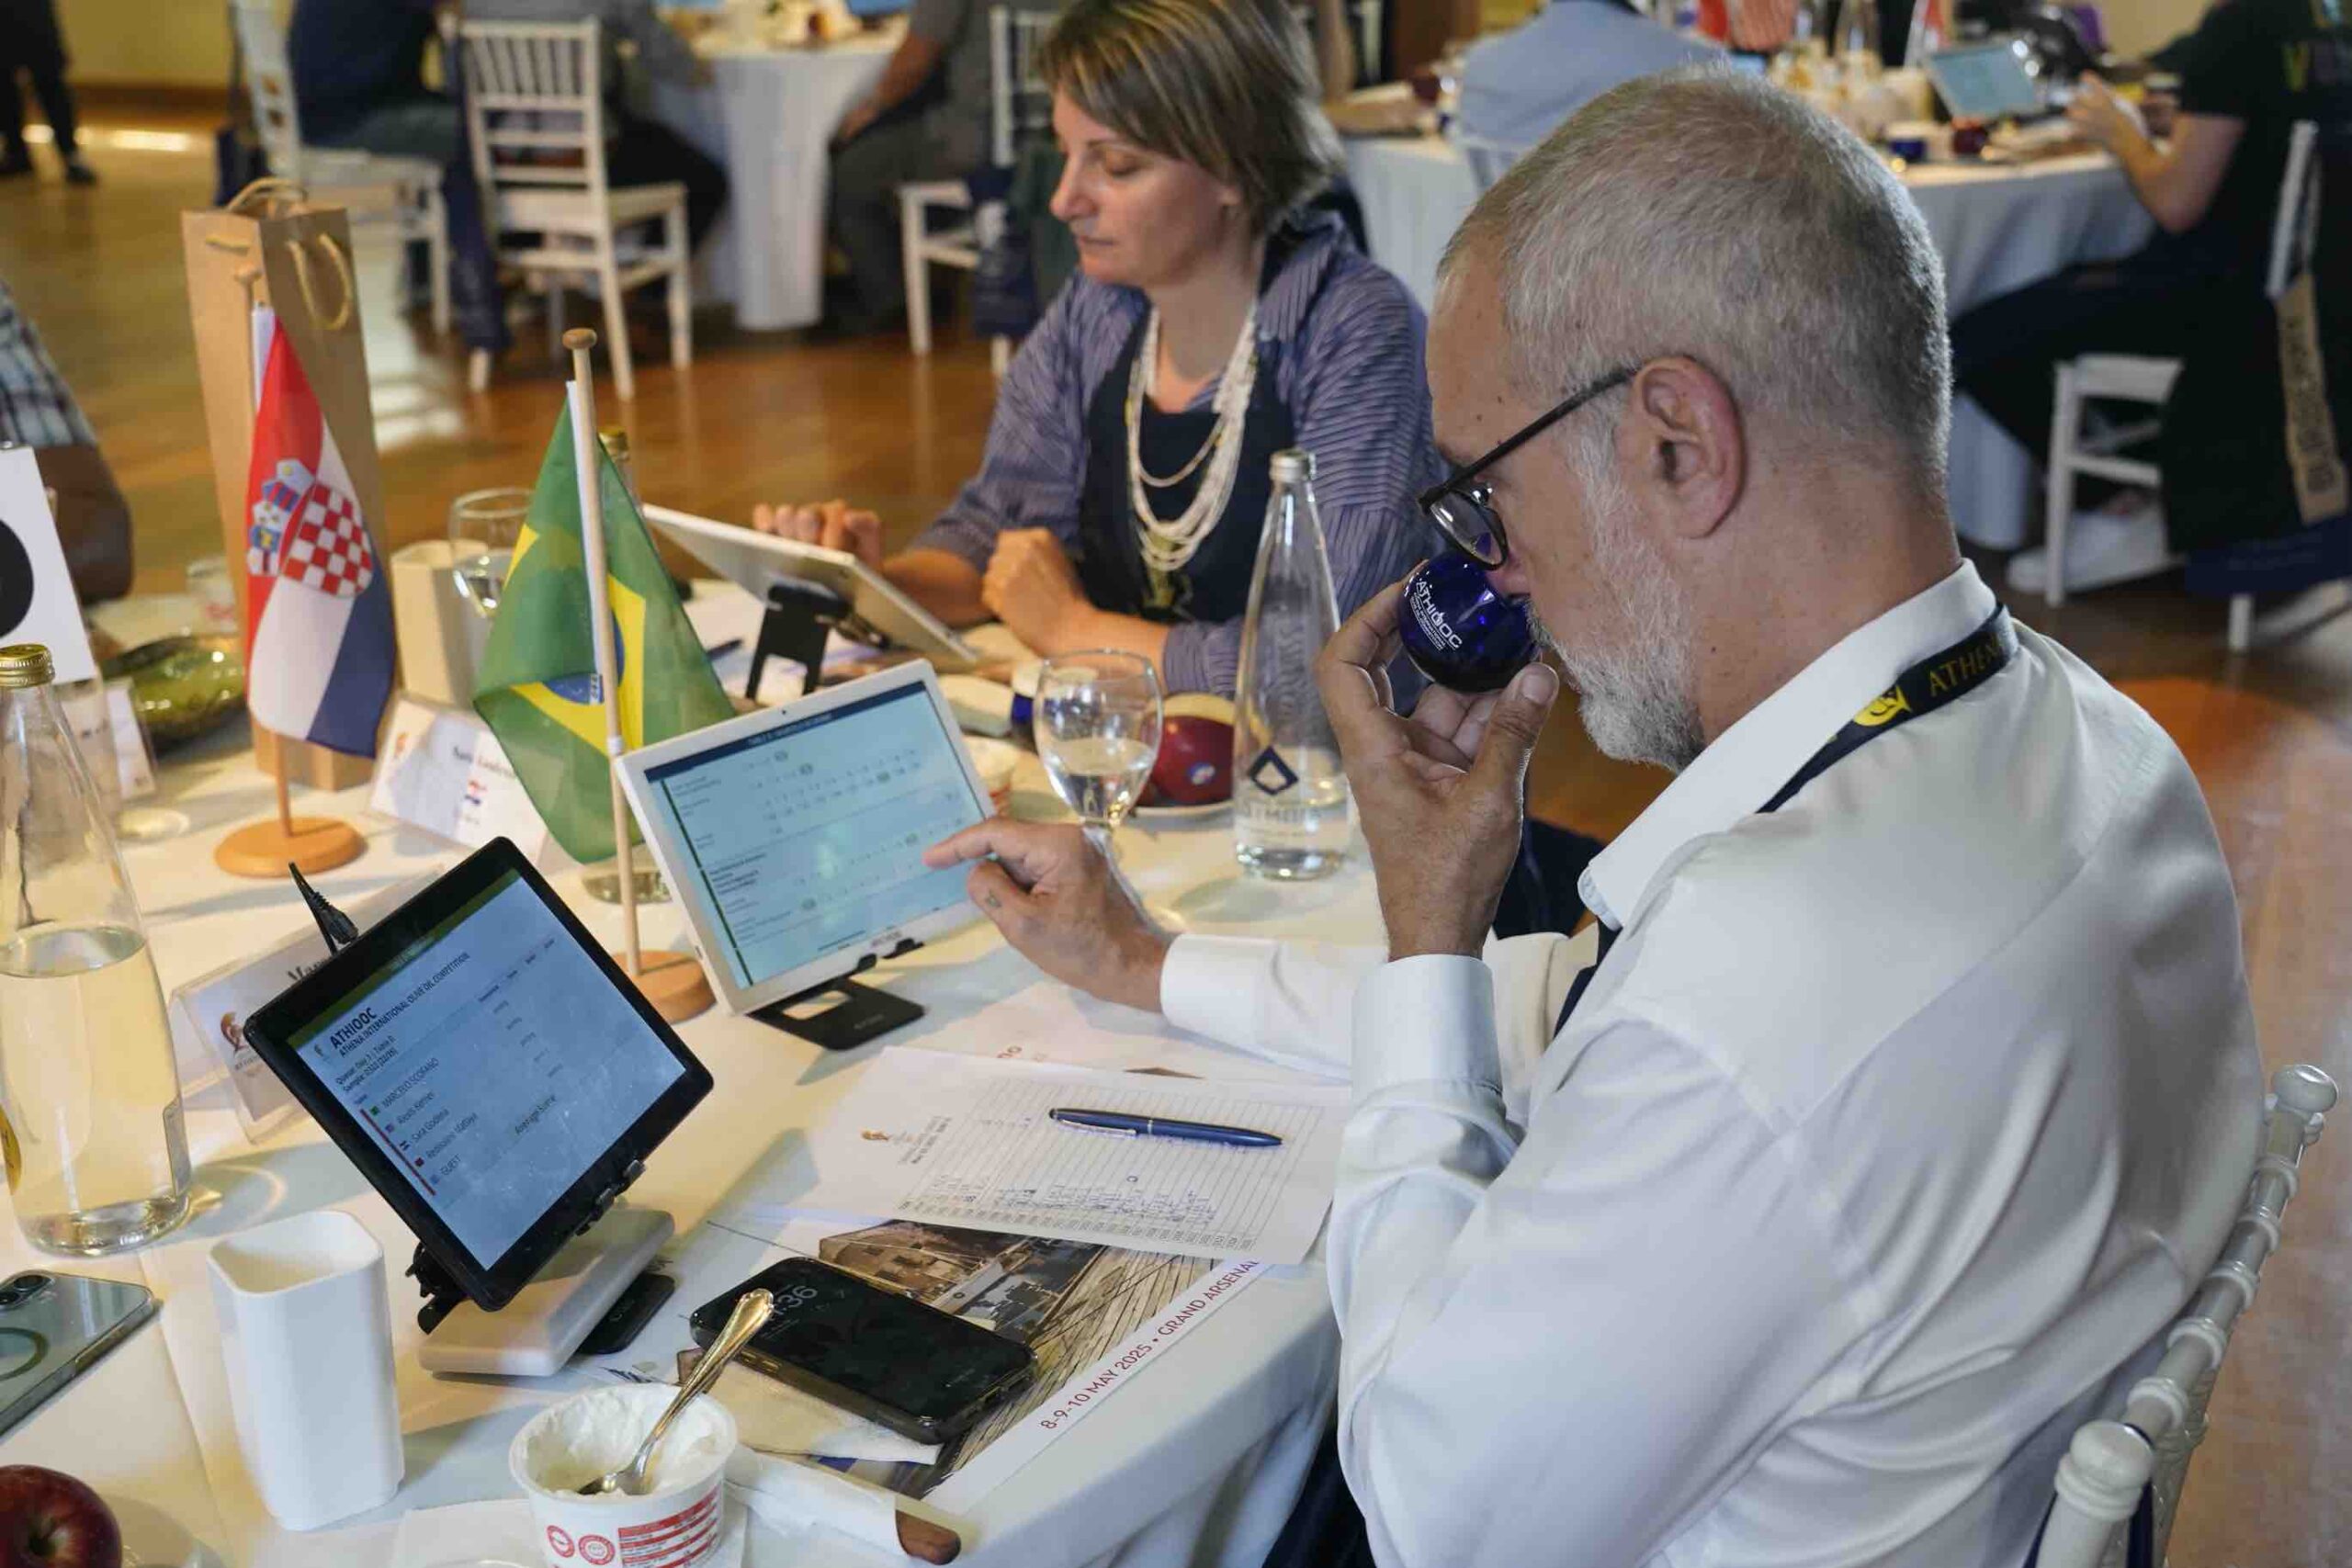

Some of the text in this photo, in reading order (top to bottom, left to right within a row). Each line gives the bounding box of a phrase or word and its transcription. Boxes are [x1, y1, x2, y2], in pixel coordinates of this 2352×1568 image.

[327, 1006, 378, 1048] ATHIOOC
[337, 1033, 366, 1057] ATHENA
[360, 998, 410, 1040] INTERNATIONAL
[1040, 1393, 1091, 1429] 8-9-10
[1086, 1370, 1118, 1393] MAY
[1115, 1344, 1152, 1370] 2025
[1159, 1299, 1205, 1337] GRAND
